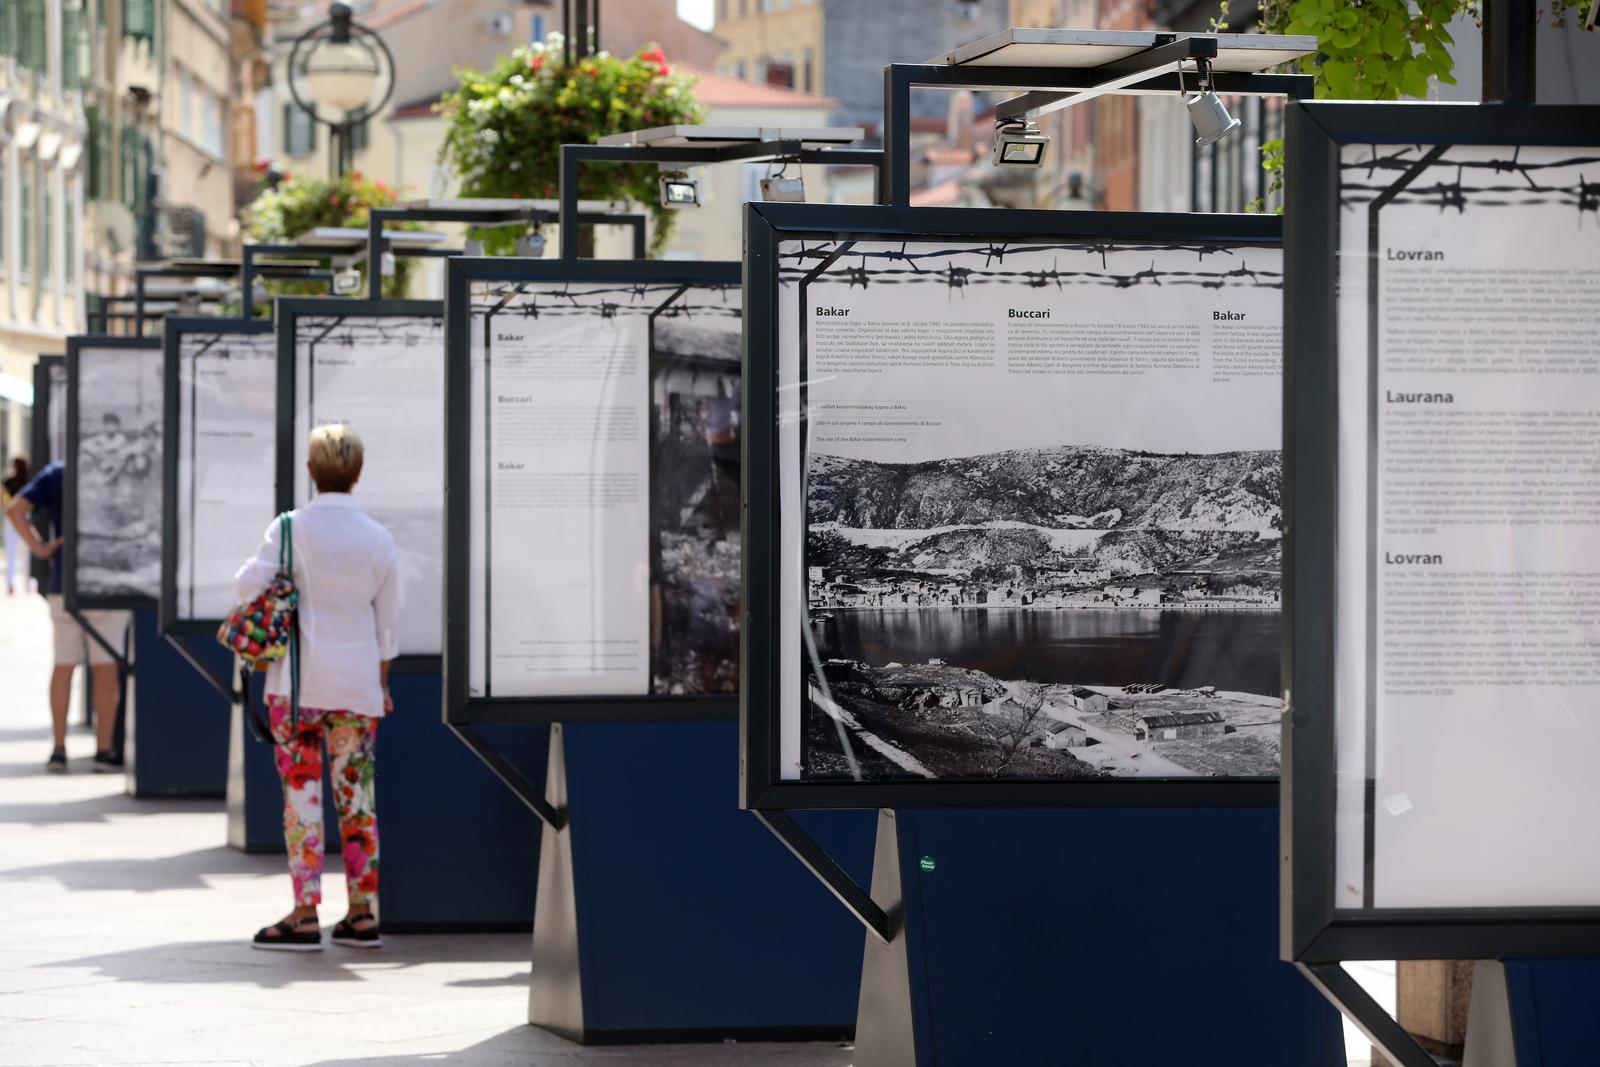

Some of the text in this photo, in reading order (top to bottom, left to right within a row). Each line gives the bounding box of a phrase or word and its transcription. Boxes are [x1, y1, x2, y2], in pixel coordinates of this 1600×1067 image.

[1387, 247, 1444, 261] Lovran
[816, 306, 850, 317] Bakar
[1008, 308, 1050, 319] Buccari
[1212, 310, 1246, 321] Bakar
[497, 333, 524, 342] Bakar
[497, 395, 532, 403] Buccari
[1386, 390, 1454, 404] Laurana
[497, 461, 525, 470] Bakar
[1385, 551, 1443, 565] Lovran
